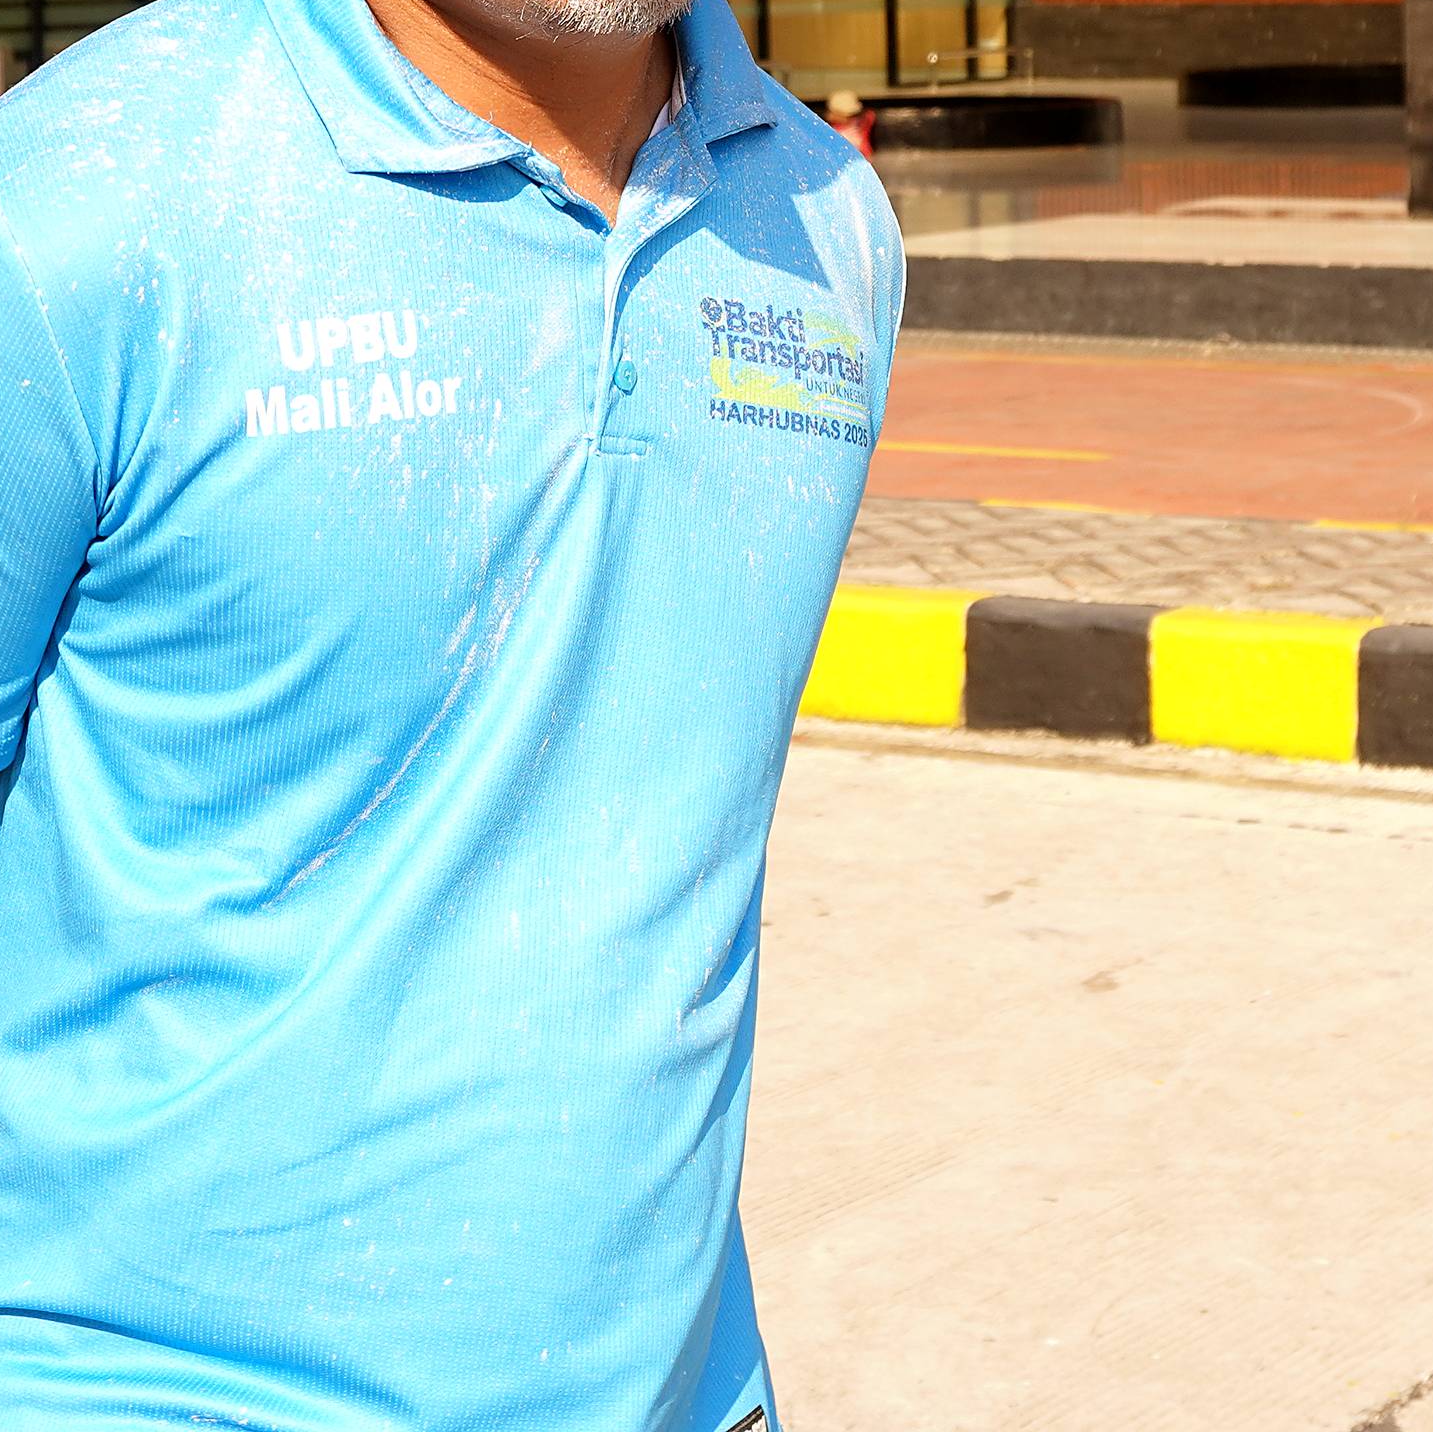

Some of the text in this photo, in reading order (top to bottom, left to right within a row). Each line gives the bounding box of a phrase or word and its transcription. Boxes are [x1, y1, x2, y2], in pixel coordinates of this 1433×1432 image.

[276, 309, 420, 372] UPBU
[723, 298, 807, 344] Bakti
[702, 321, 865, 387] Transportasi
[245, 369, 464, 438] Mali Alor
[806, 376, 843, 400] UNTUK
[709, 399, 869, 448] HARHUBNAS 2025
